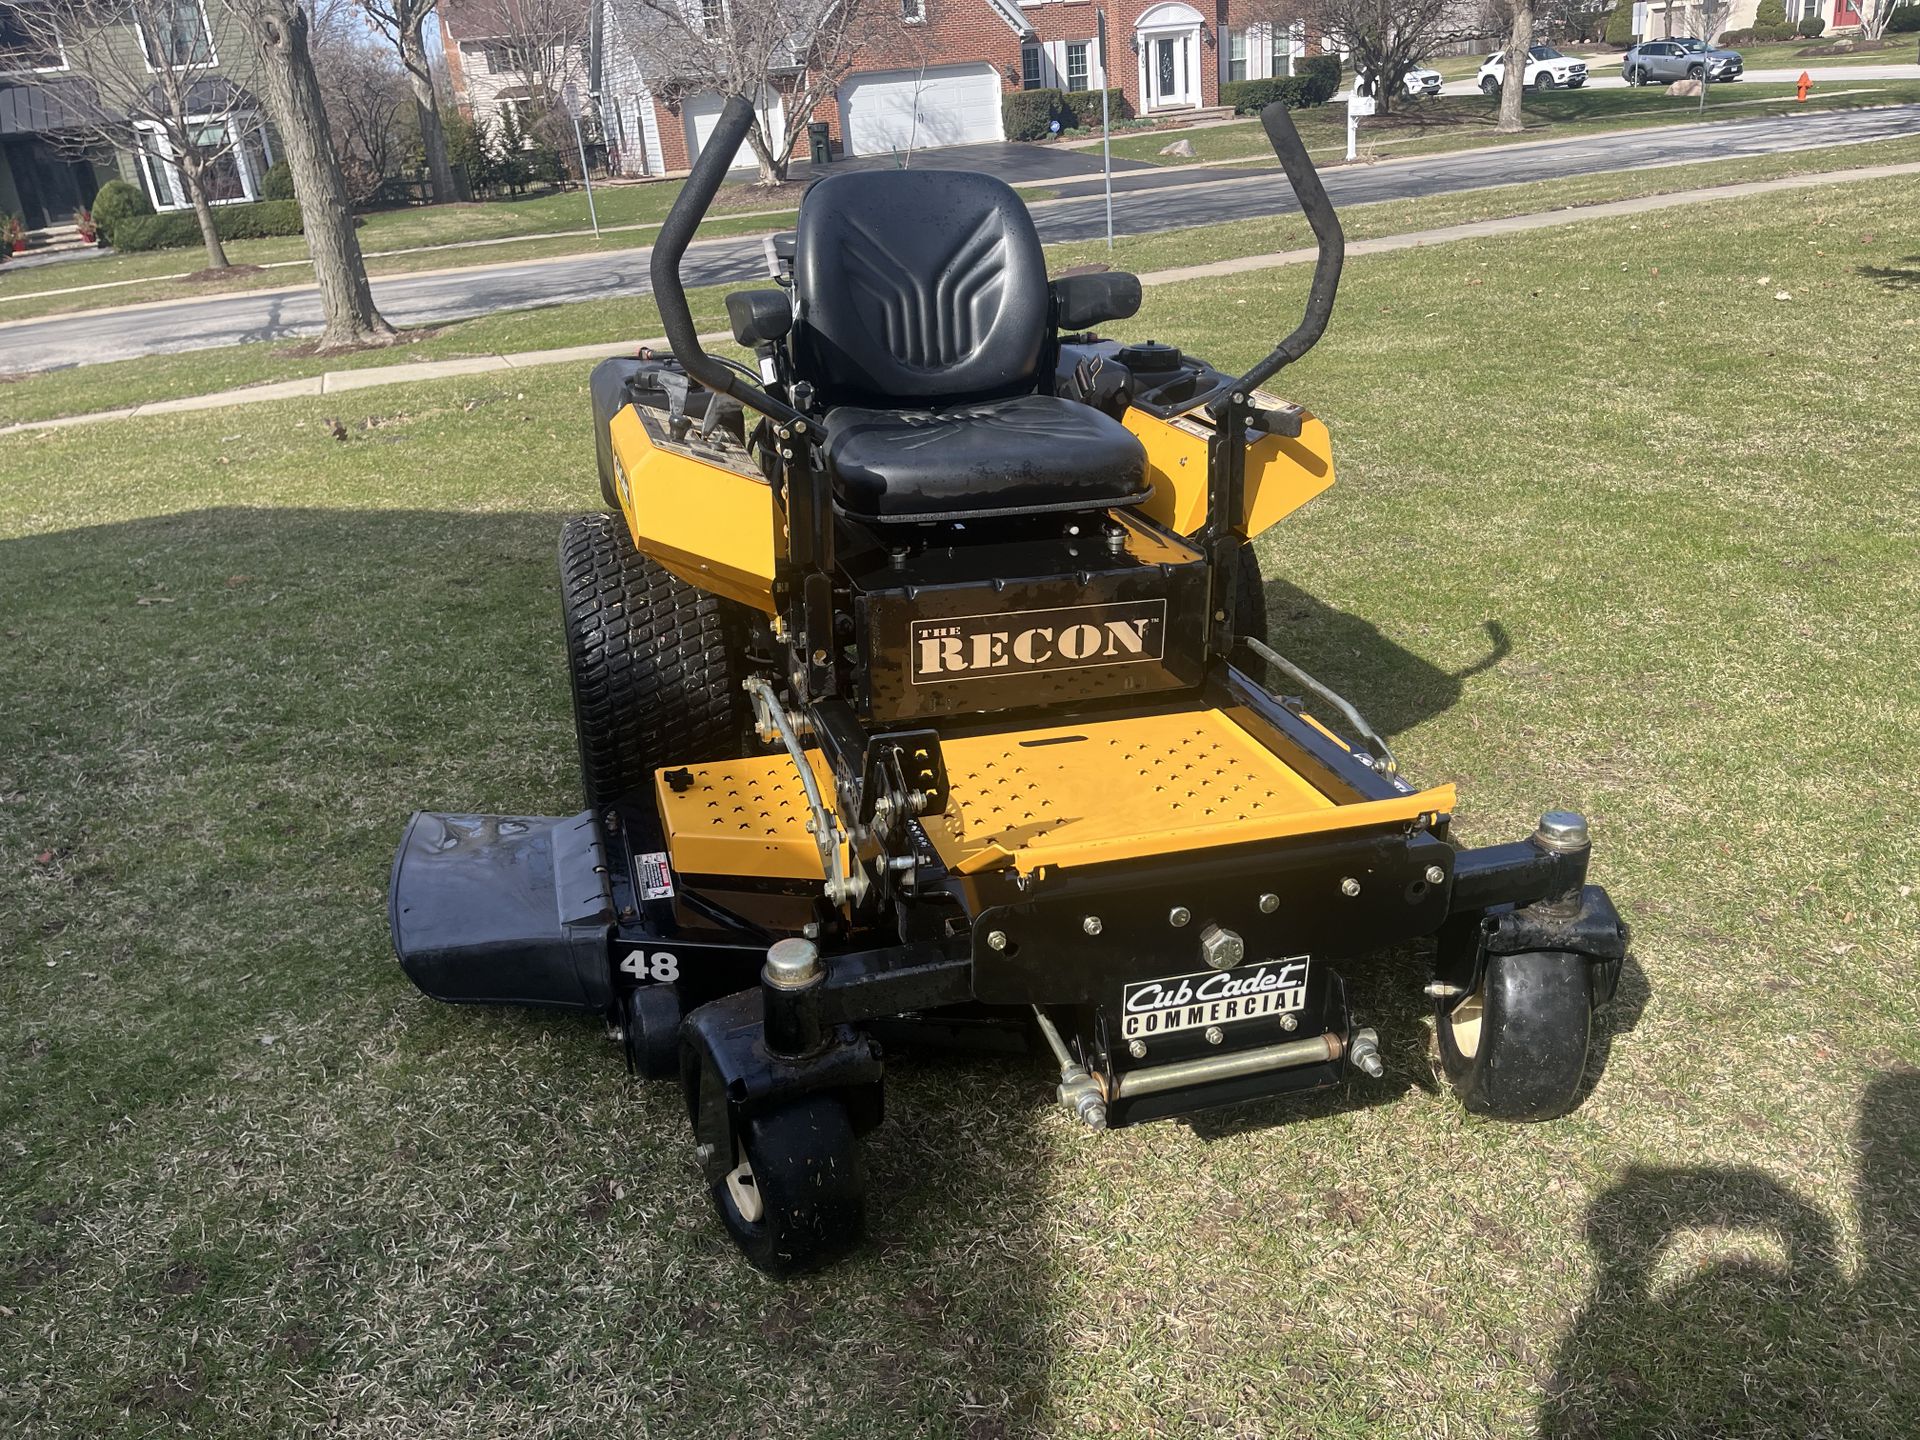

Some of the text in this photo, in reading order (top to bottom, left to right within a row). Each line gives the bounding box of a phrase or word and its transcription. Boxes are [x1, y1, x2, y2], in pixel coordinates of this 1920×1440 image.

[918, 626, 961, 638] THE
[918, 618, 1150, 674] RECON
[619, 949, 680, 982] 48
[1126, 990, 1302, 1036] COMMERCIAL
[1127, 979, 1193, 1013] Cub
